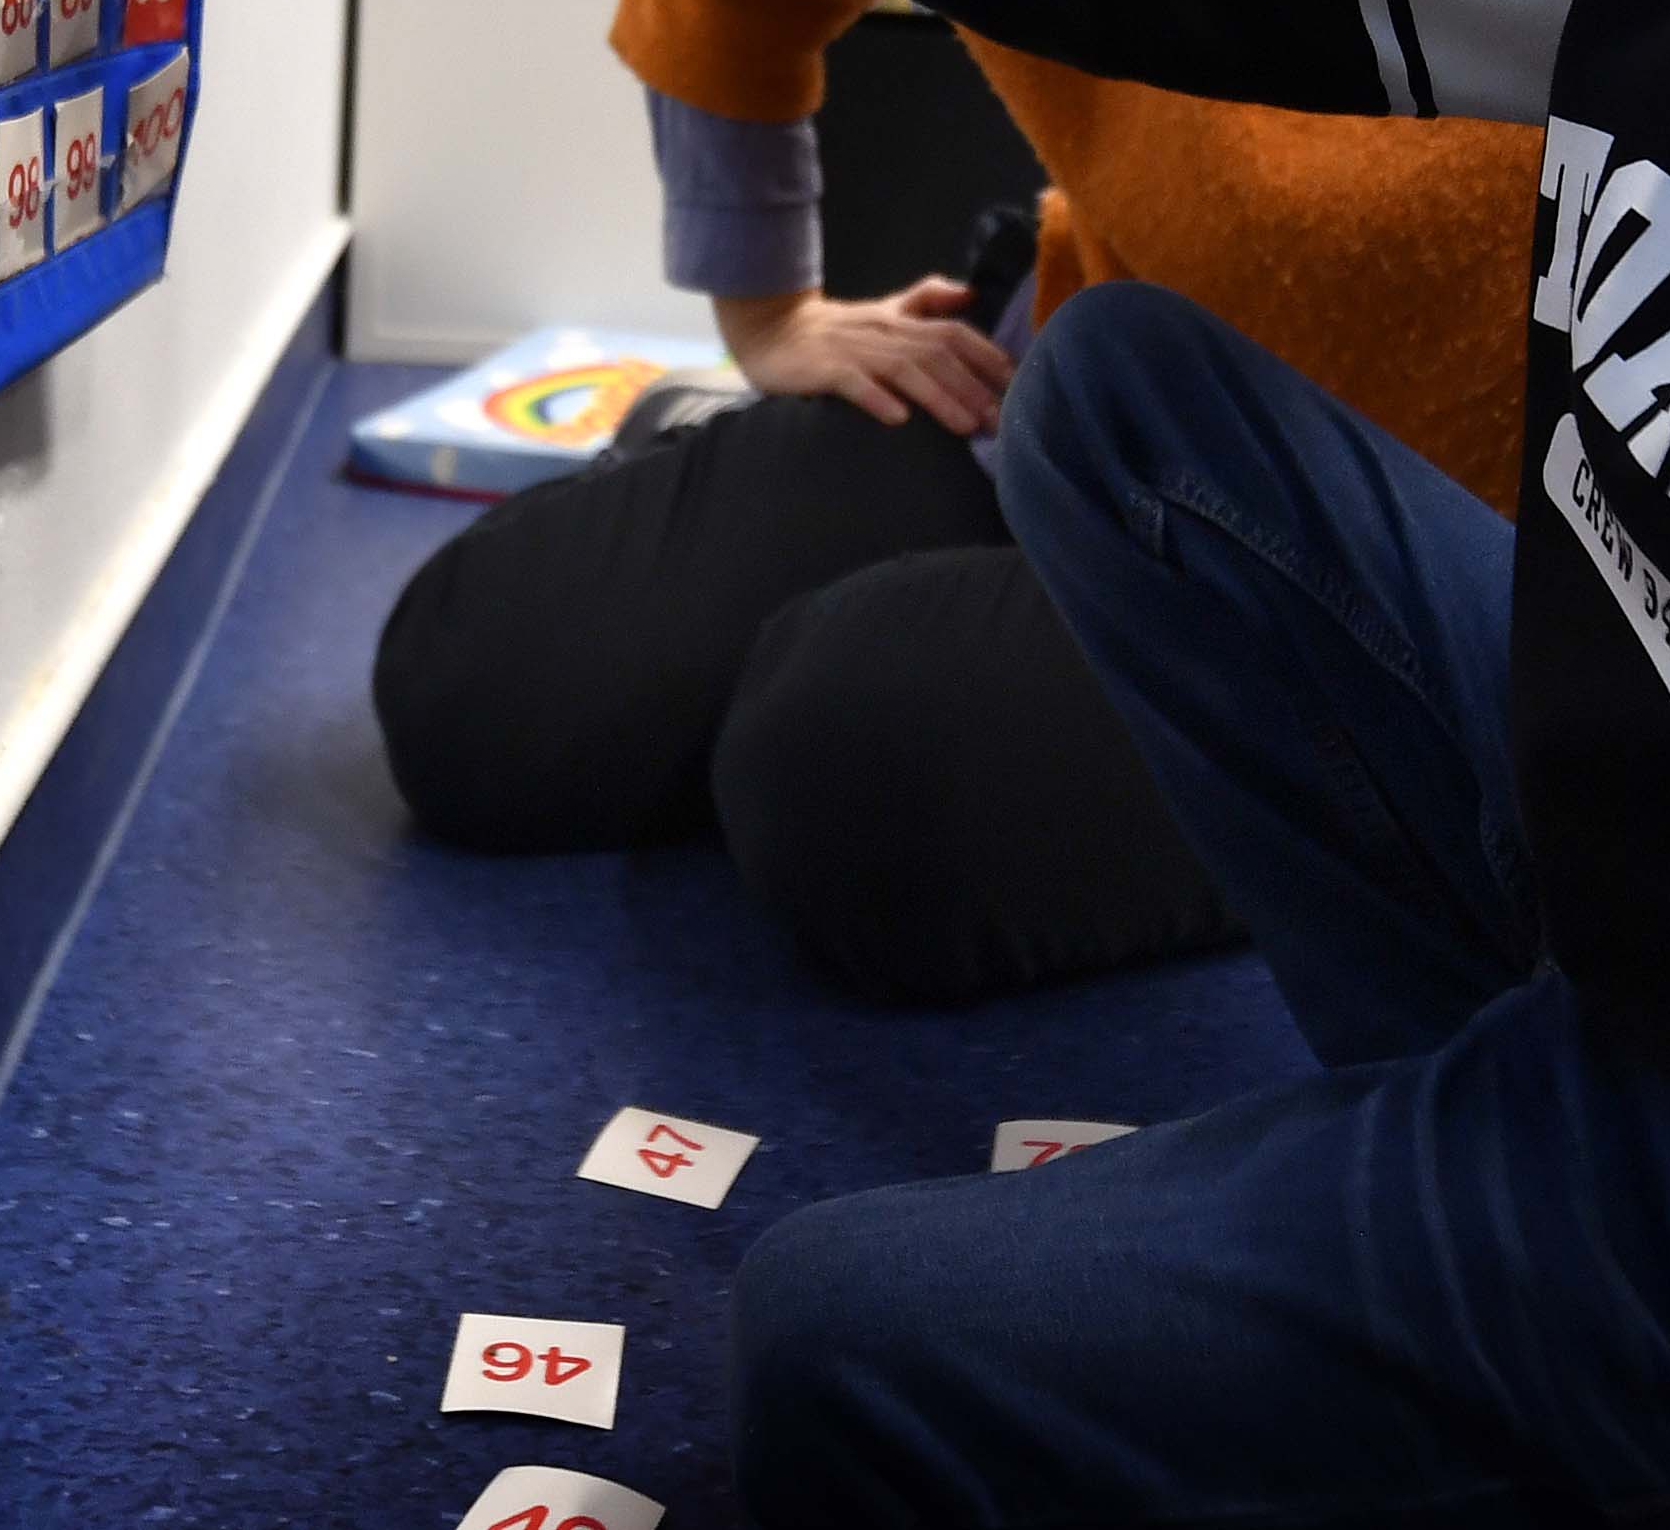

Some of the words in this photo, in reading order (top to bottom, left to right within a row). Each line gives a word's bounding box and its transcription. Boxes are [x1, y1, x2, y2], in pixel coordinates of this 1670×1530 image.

[133, 87, 185, 165] 100
[8, 157, 39, 228] 98
[66, 133, 96, 200] 99
[1572, 458, 1633, 582] CREW
[638, 1124, 705, 1178] 47
[1022, 1140, 1090, 1168] 7
[482, 1342, 592, 1385] 46
